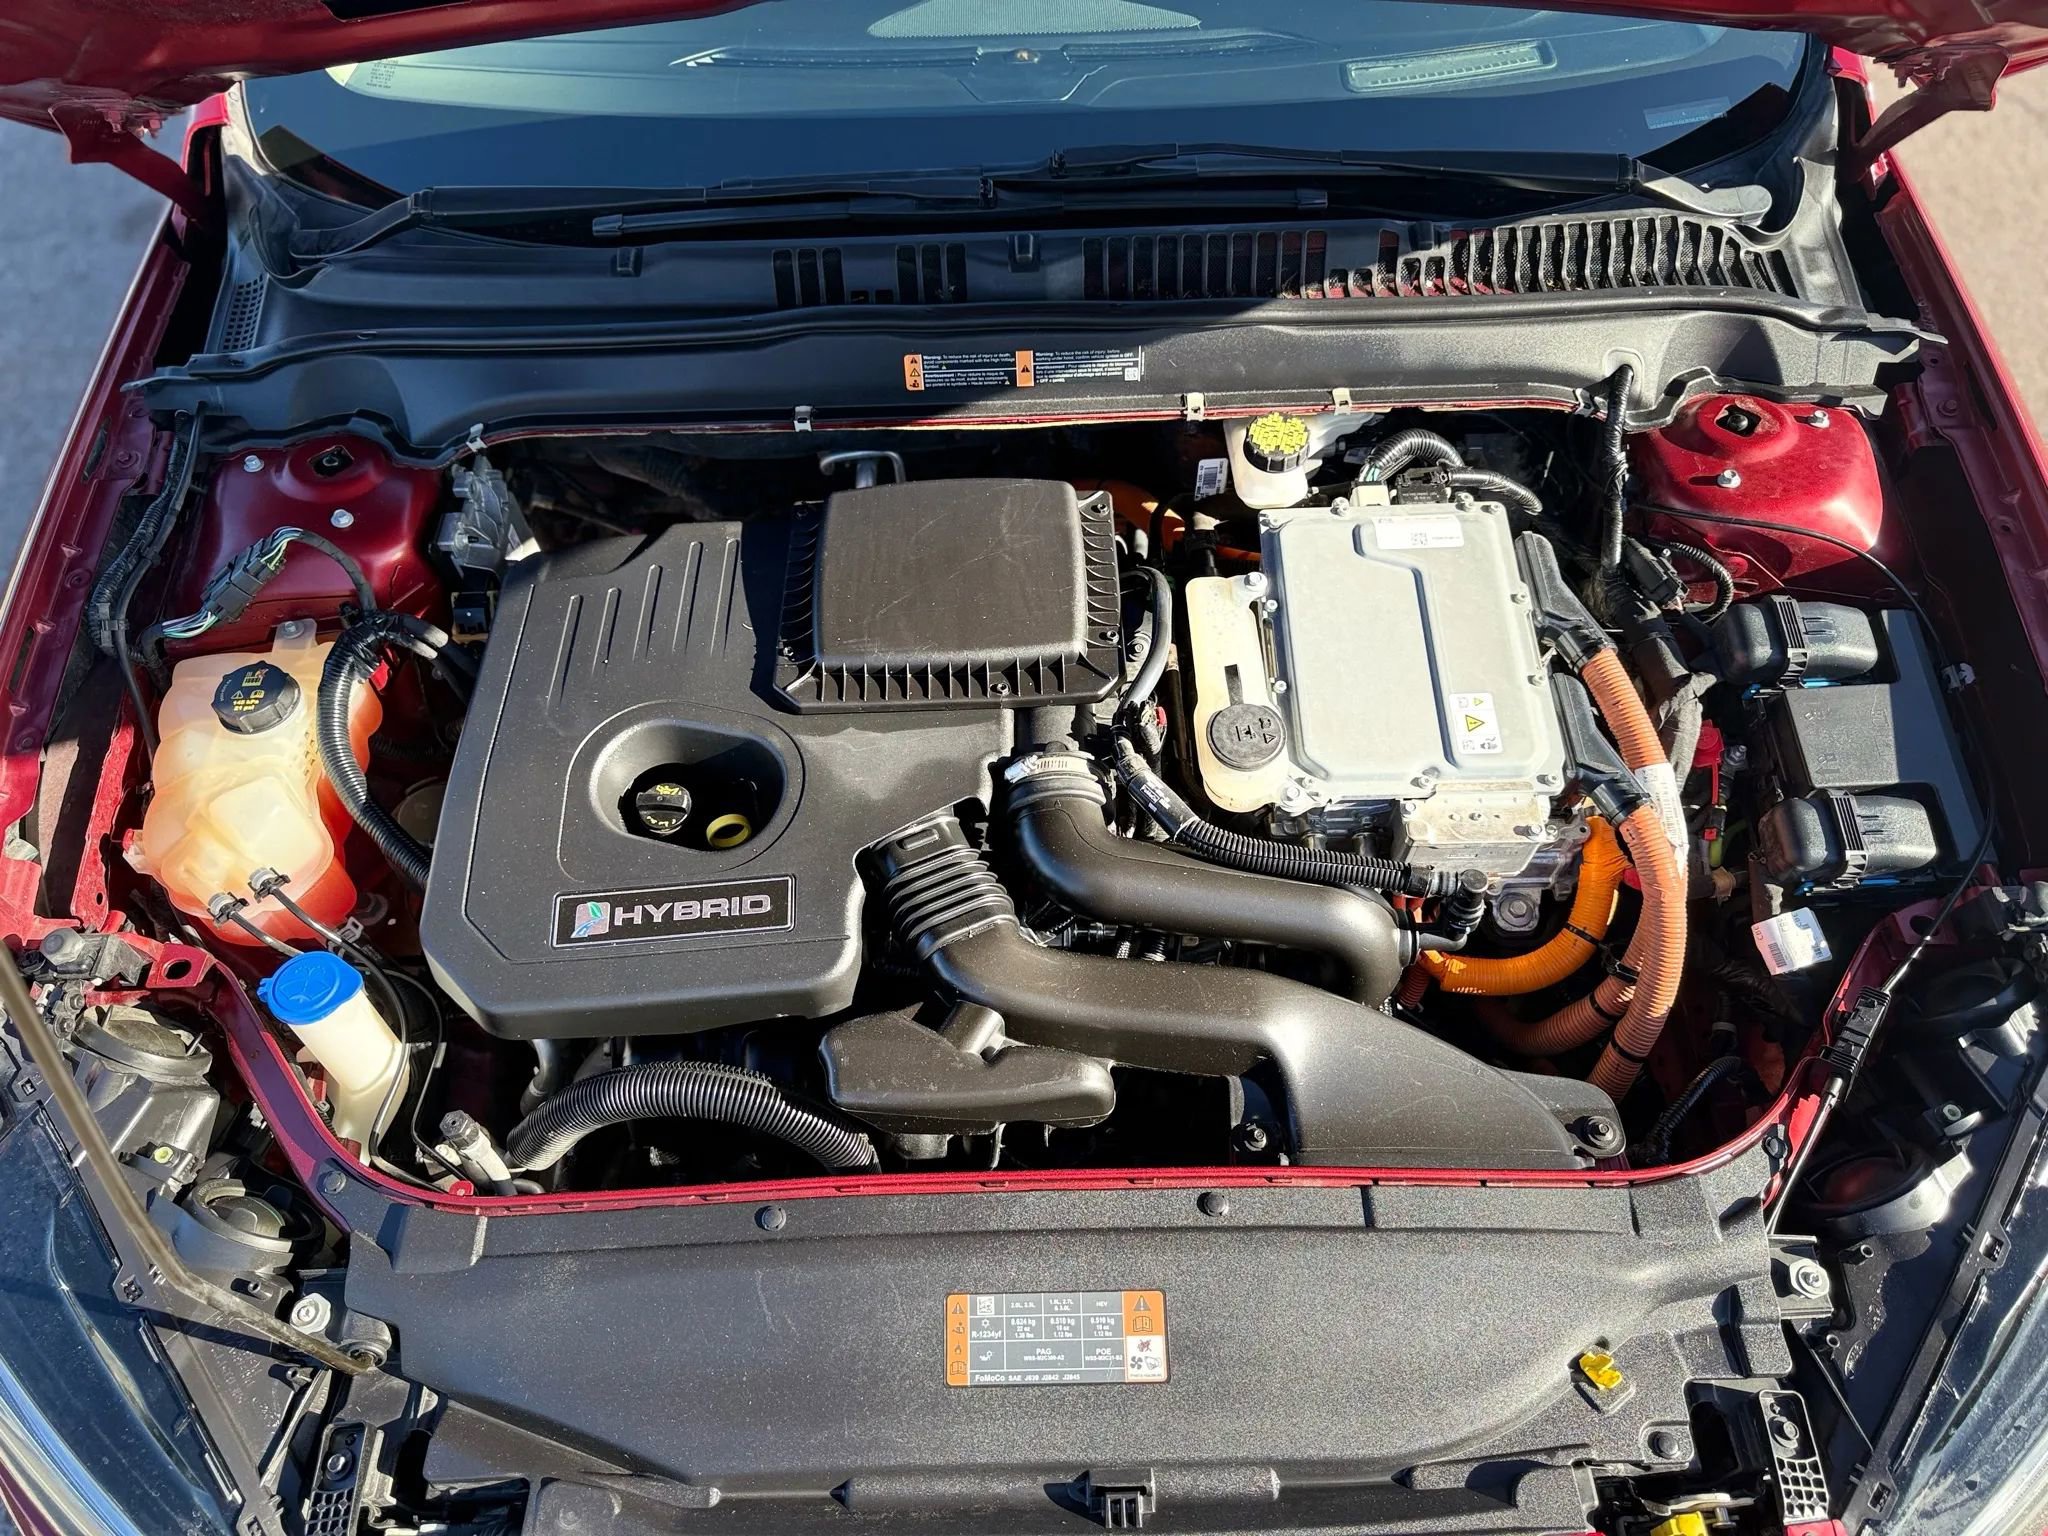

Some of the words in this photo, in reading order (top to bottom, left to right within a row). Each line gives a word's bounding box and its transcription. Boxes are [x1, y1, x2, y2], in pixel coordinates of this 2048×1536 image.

[614, 894, 771, 926] HYBRID
[1067, 1317, 1075, 1325] kg
[1107, 1317, 1115, 1325] kg
[972, 1330, 1002, 1339] R-1234yf
[975, 1374, 1005, 1382] FoMoCo
